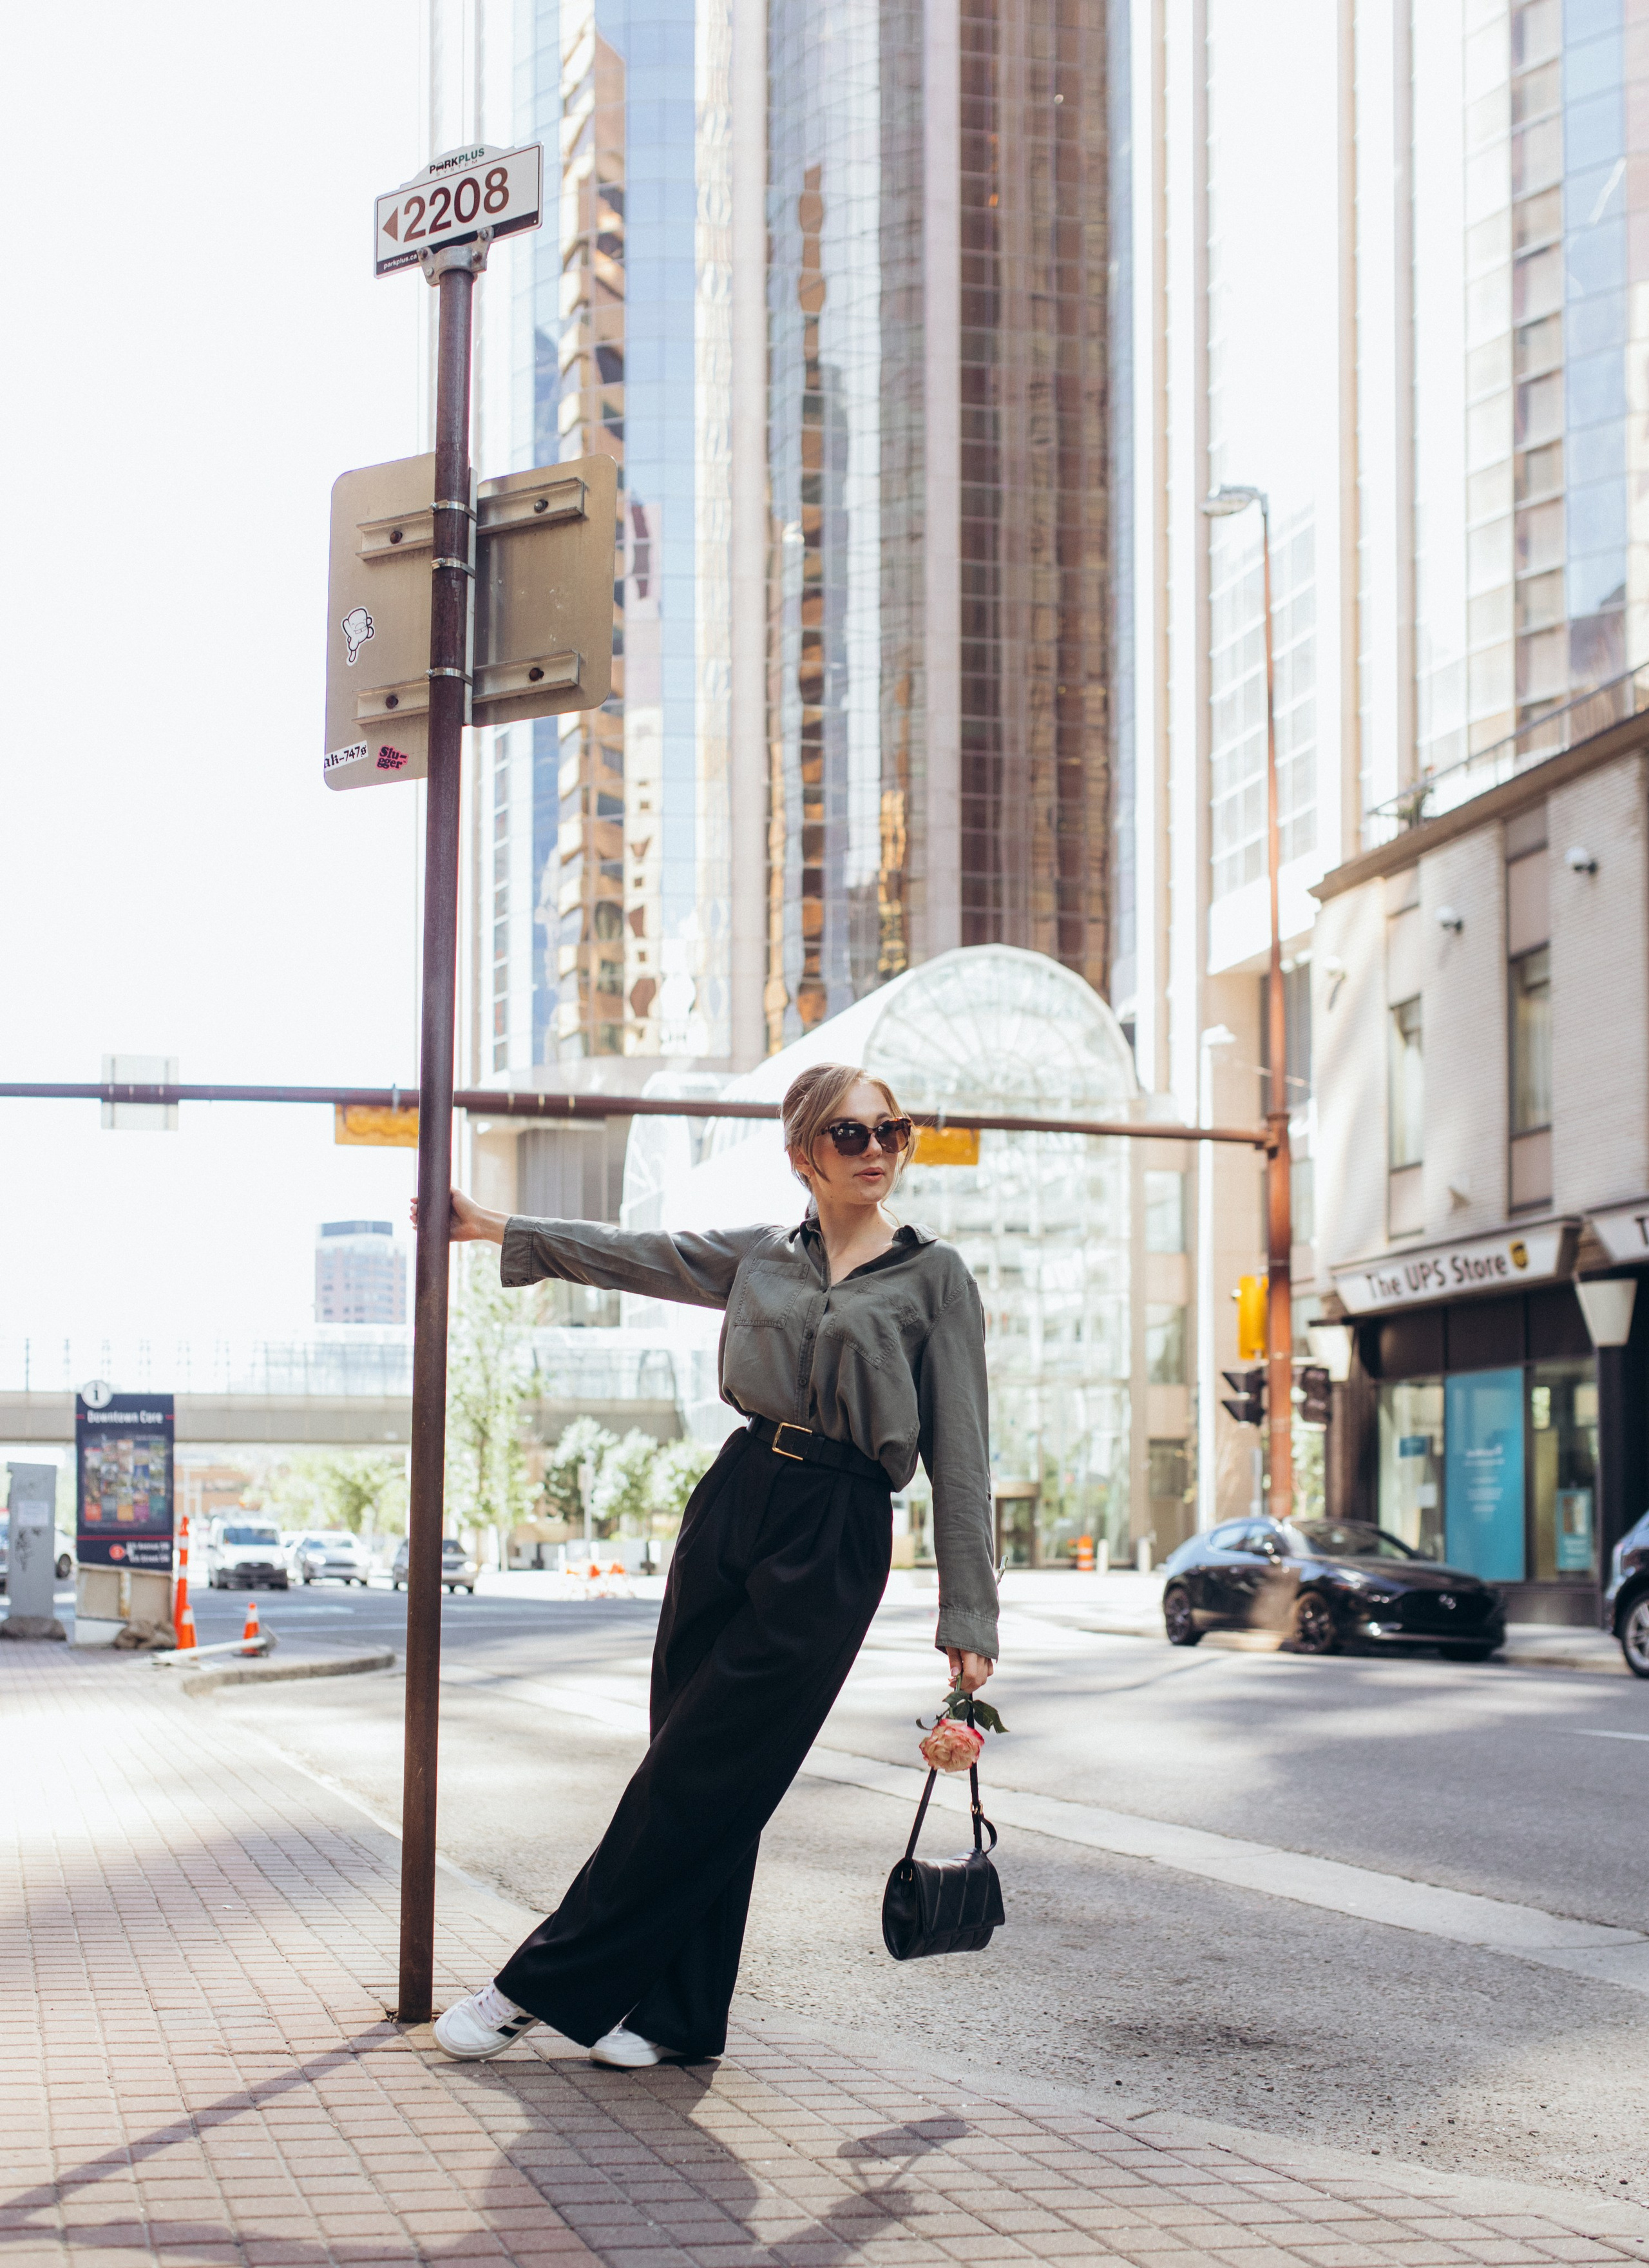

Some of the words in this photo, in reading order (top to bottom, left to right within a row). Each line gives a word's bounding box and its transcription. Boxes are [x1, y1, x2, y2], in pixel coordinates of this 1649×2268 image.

[436, 159, 478, 177] SYSTEM
[403, 167, 510, 243] 2208
[383, 254, 417, 270] parkplus.ca
[1366, 1273, 1401, 1299] The
[1404, 1258, 1445, 1291] UPS
[1451, 1254, 1508, 1283] Store
[87, 1410, 139, 1424] Downtown
[140, 1410, 164, 1424] Core
